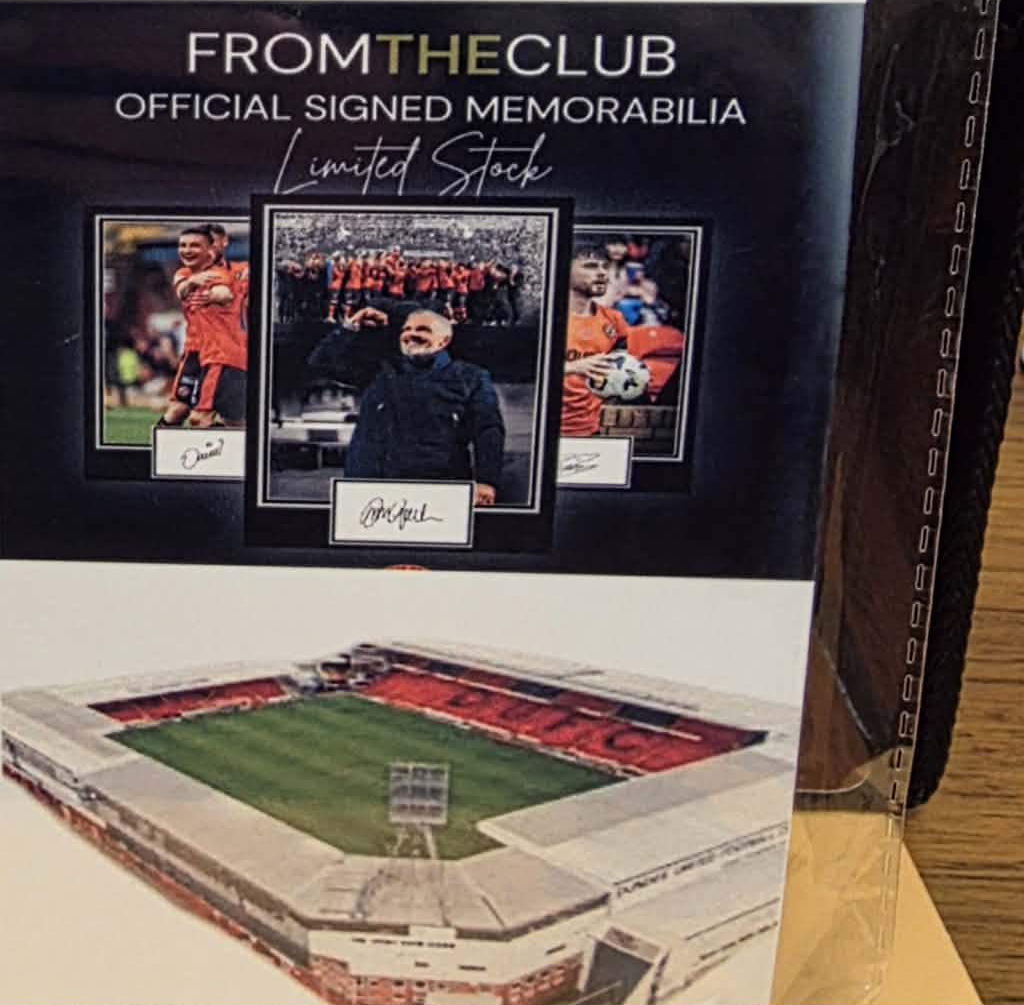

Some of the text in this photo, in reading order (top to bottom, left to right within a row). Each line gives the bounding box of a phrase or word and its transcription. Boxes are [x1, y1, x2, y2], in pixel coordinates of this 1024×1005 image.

[188, 32, 676, 77] FROMTHECLUB
[115, 93, 746, 125] OFFICIAL SIGNED MEMORABILIA
[273, 128, 553, 197] Limited Stock
